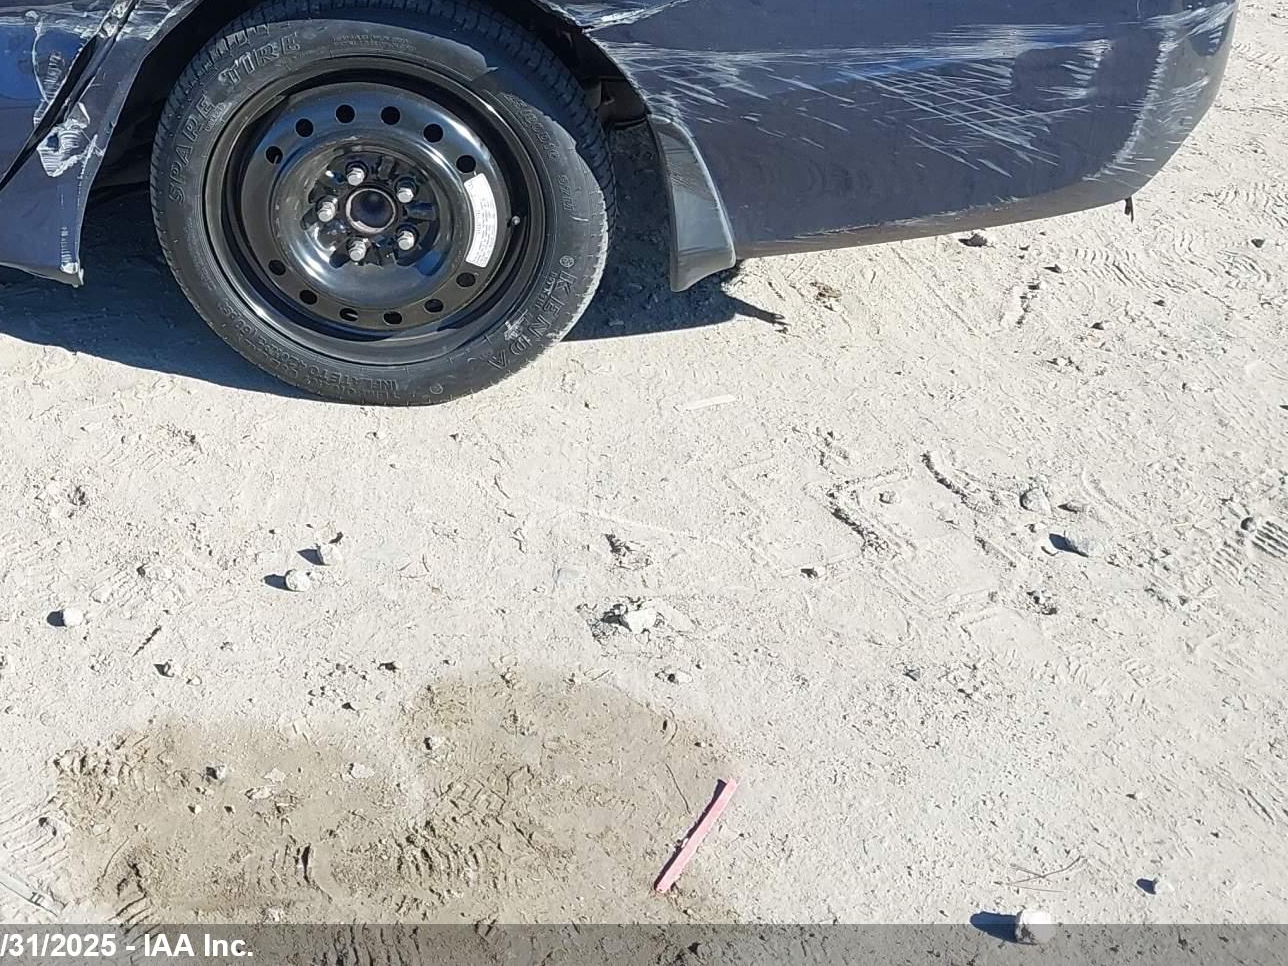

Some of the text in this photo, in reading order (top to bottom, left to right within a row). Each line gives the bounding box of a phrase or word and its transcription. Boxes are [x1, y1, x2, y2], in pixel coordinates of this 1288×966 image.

[168, 31, 301, 203] SPARE TIRE
[487, 270, 578, 371] KENDA
